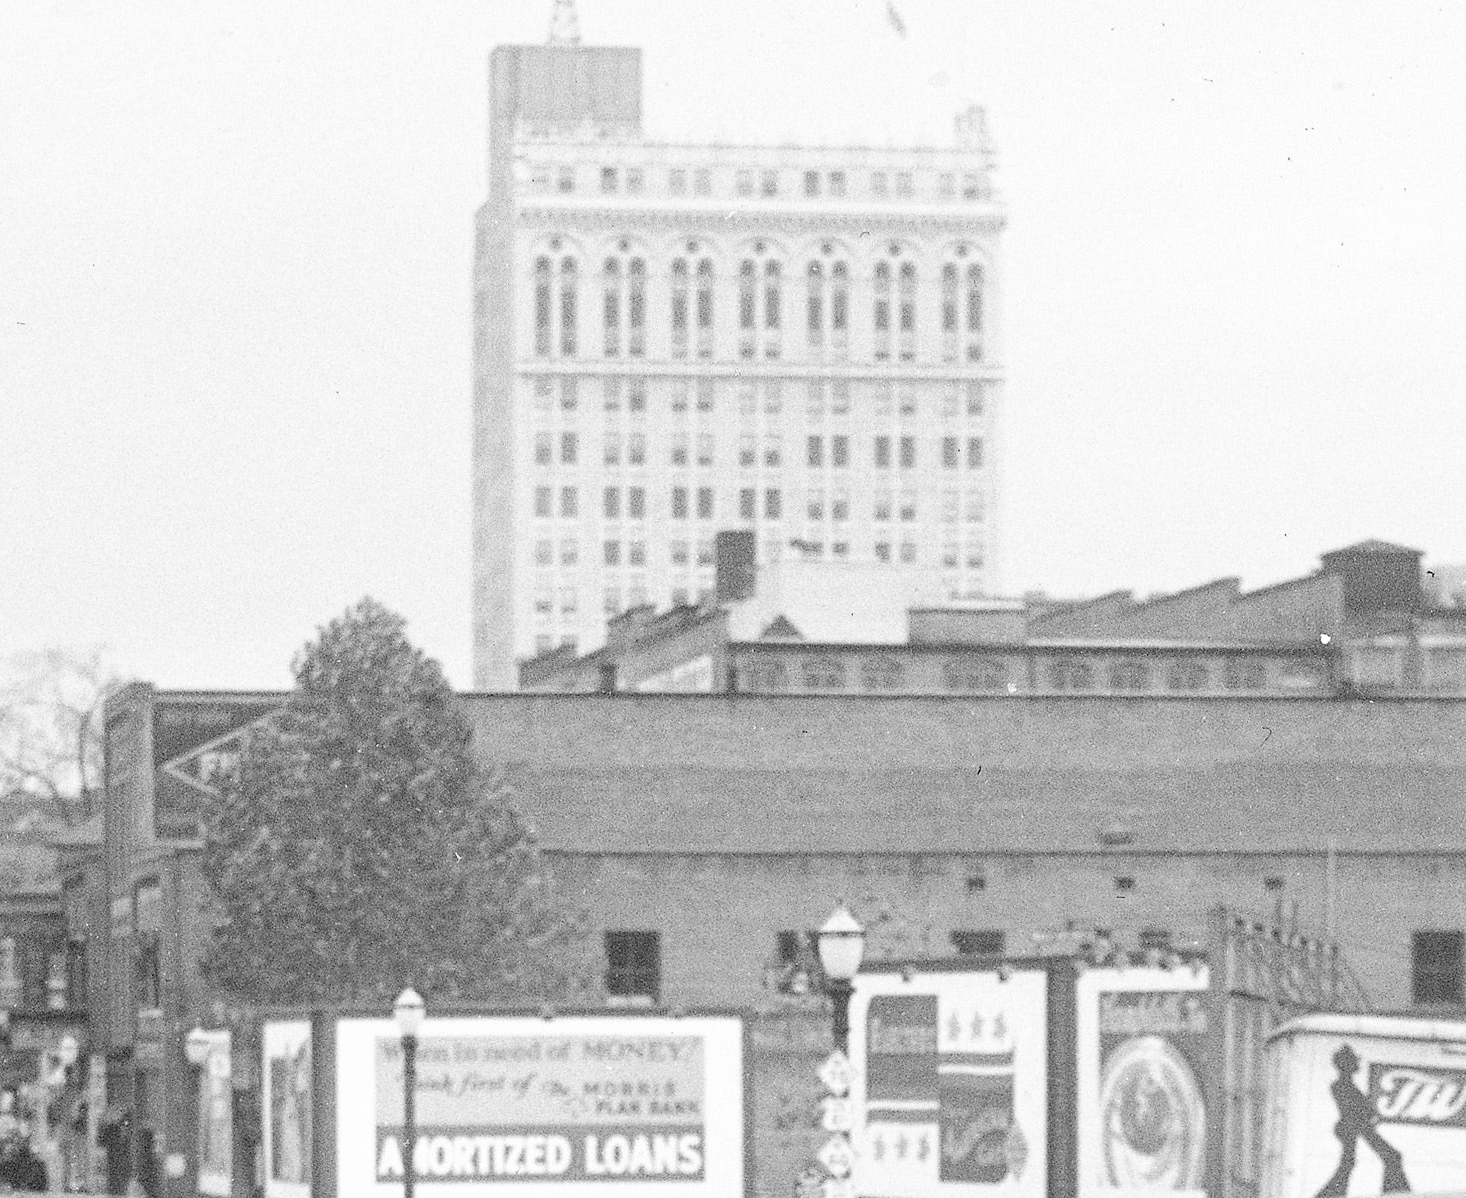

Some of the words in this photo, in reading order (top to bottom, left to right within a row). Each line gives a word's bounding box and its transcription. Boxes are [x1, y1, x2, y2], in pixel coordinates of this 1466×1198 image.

[383, 1040, 449, 1062] Wen
[546, 1040, 572, 1061] of
[583, 1079, 677, 1098] MORRIS
[585, 1134, 702, 1176] LOANS
